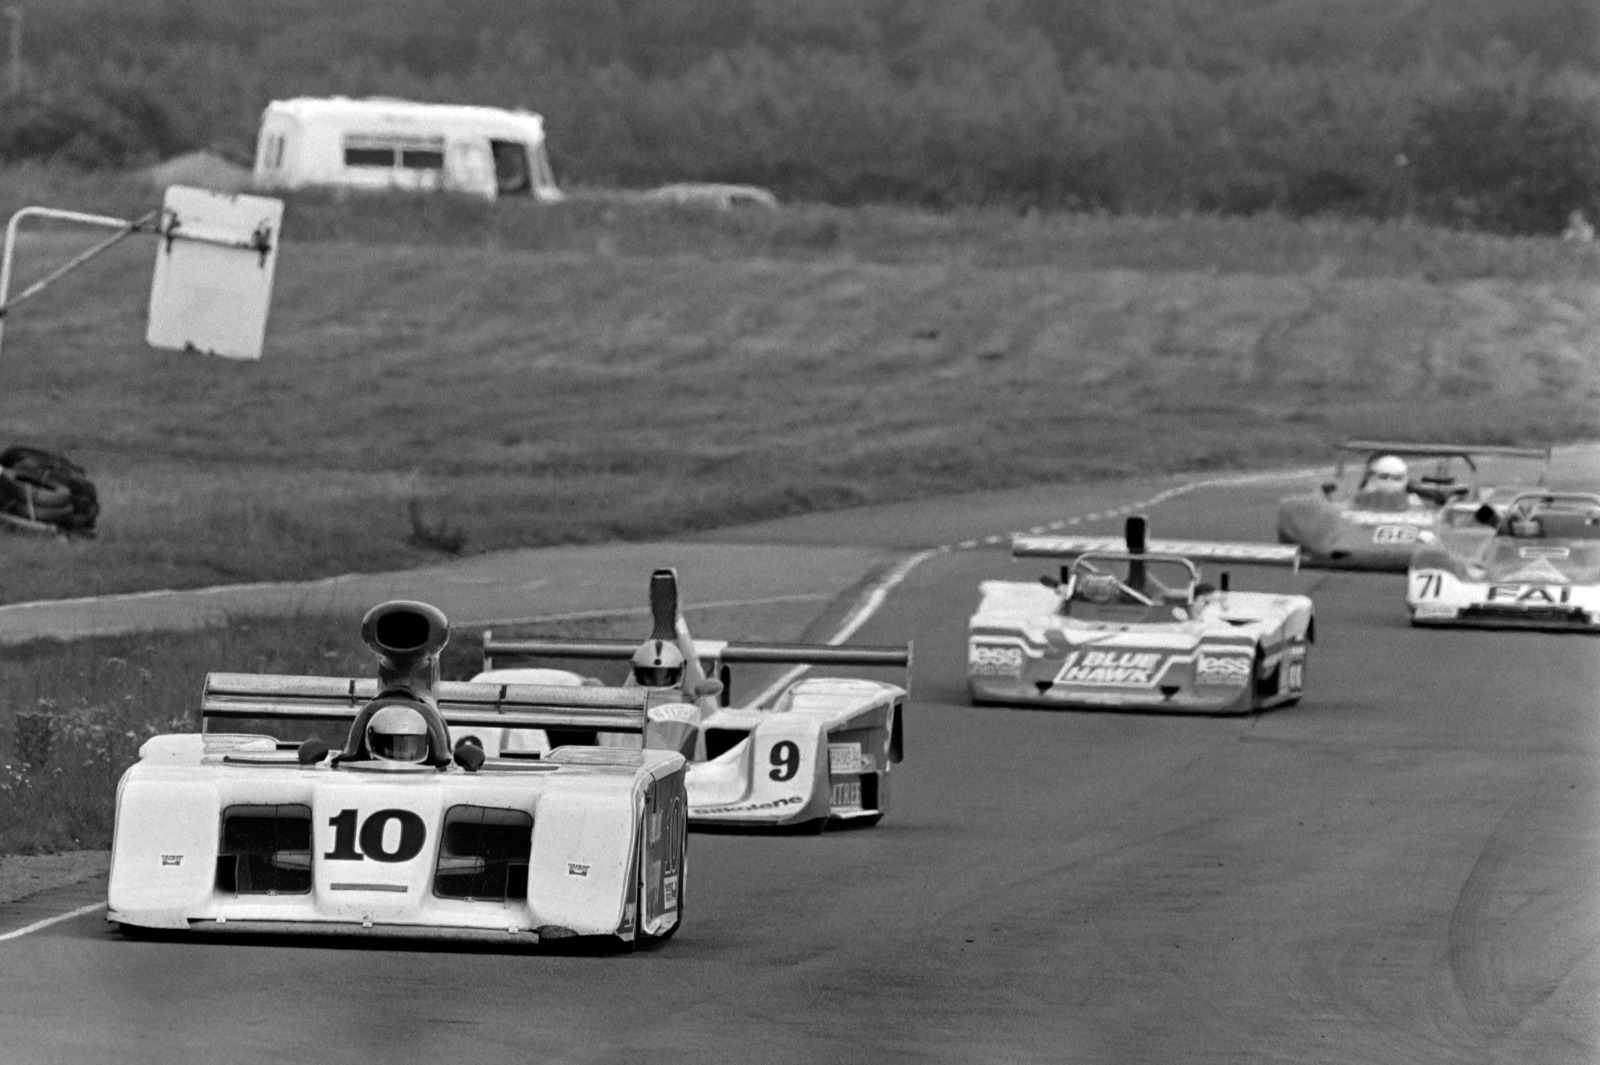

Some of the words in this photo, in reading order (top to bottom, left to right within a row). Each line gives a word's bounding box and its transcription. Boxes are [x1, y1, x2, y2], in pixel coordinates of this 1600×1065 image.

[1416, 574, 1442, 599] 71
[1081, 651, 1162, 669] BLUE
[1063, 667, 1152, 682] HAWK
[768, 740, 800, 782] 9
[324, 808, 427, 863] 10
